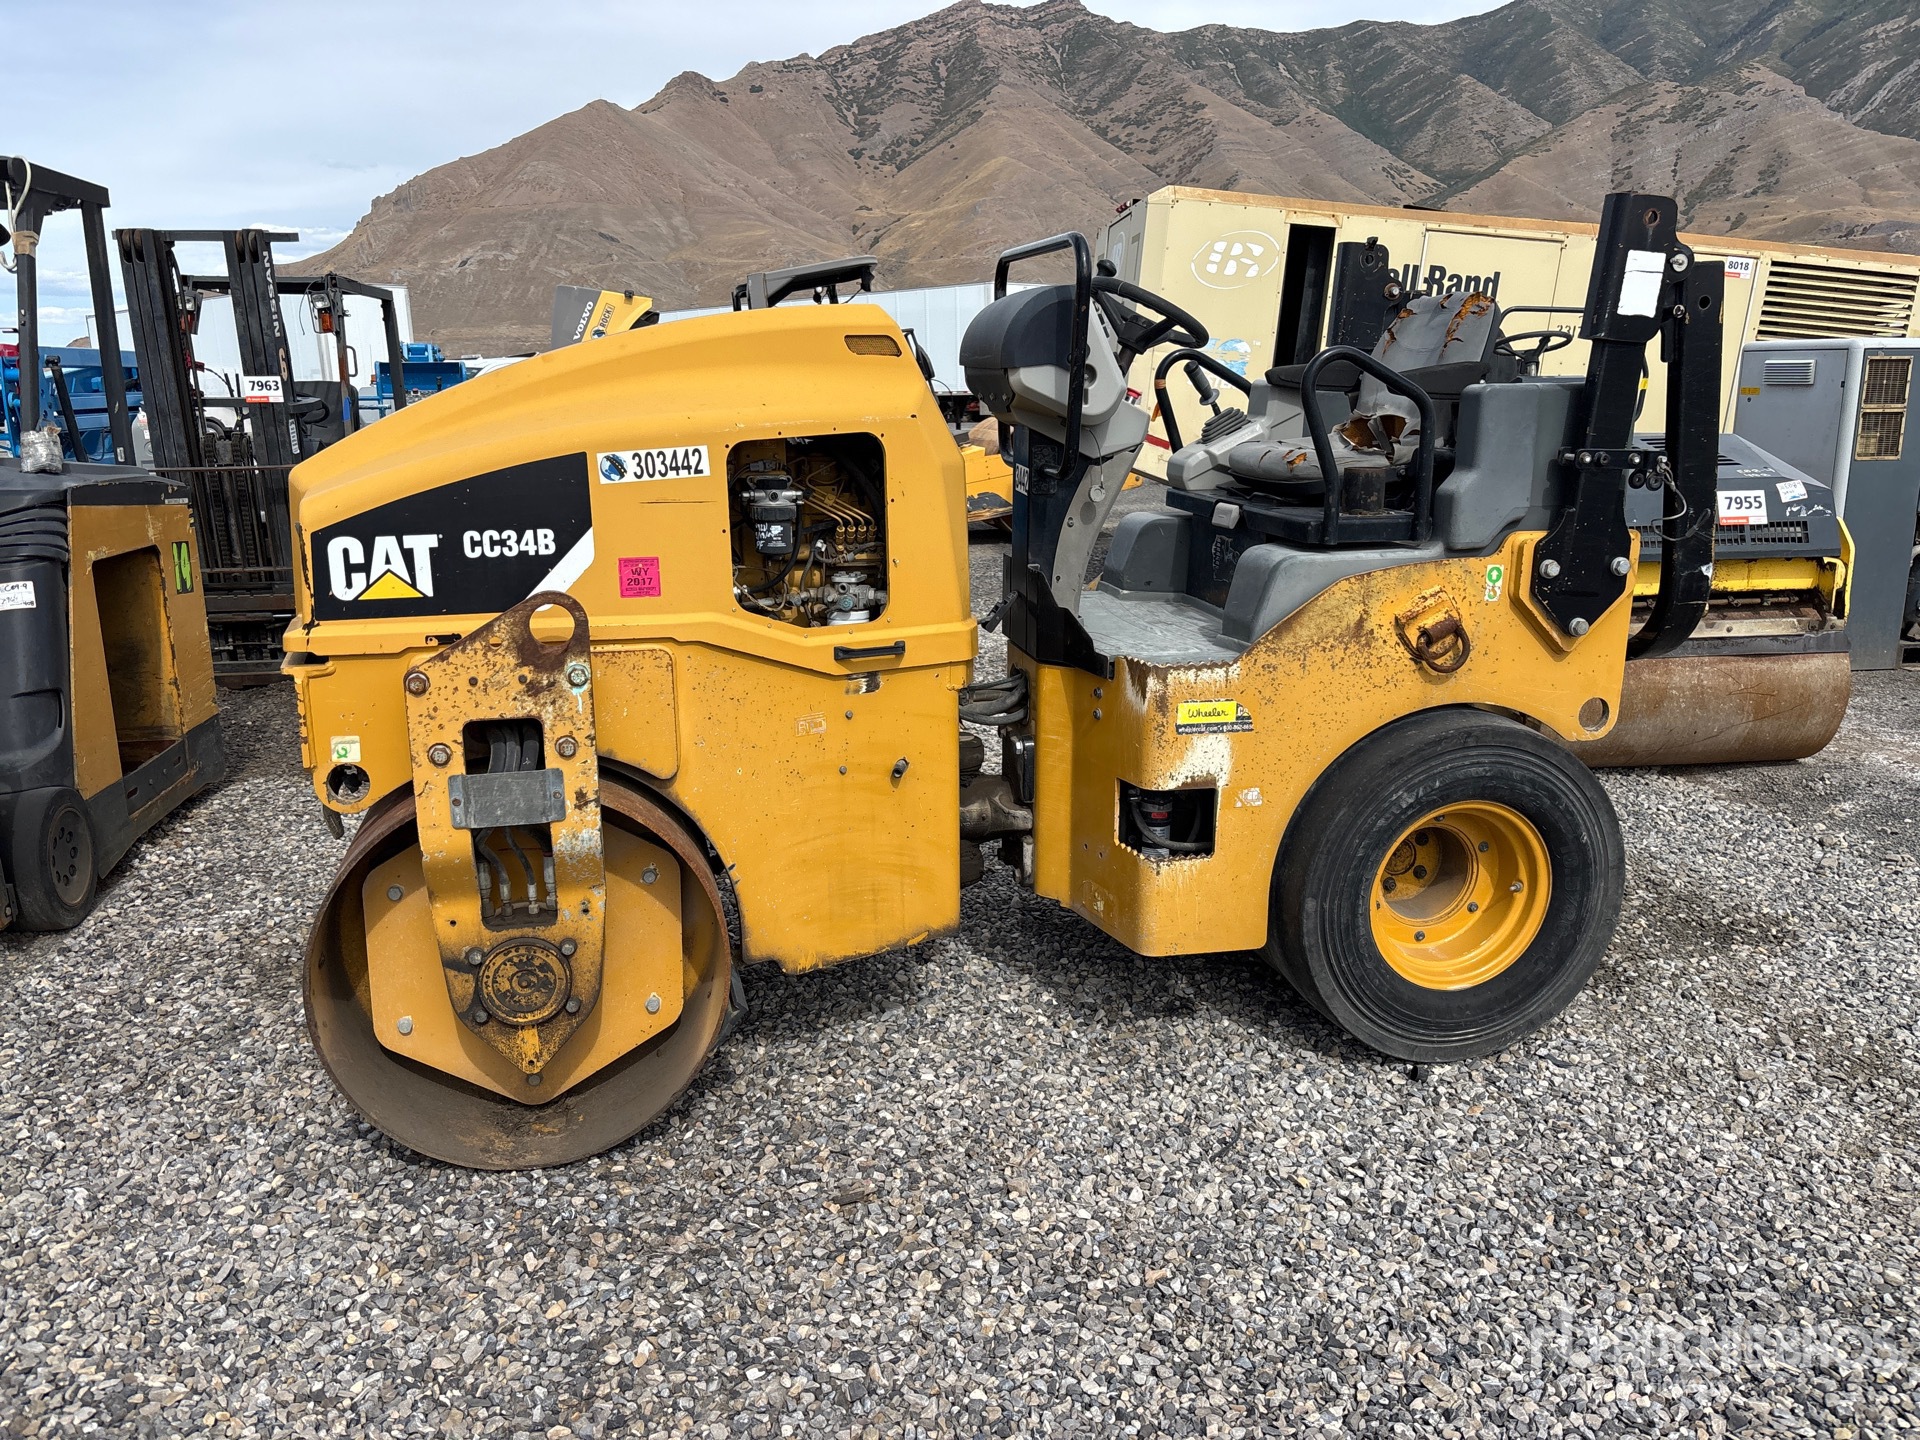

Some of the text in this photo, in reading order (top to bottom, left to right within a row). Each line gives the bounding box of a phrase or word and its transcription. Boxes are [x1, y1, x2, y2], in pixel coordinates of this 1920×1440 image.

[1728, 261, 1750, 271] 8018
[263, 251, 280, 338] NISSAN
[573, 301, 594, 340] VOLVO
[248, 380, 280, 391] 7963
[632, 448, 704, 479] 303442
[1724, 495, 1763, 510] 7955
[462, 528, 557, 559] CC34B
[326, 533, 440, 601] CAT
[631, 567, 649, 576] WY
[627, 577, 653, 586] 2017
[1188, 707, 1229, 718] Wheeler
